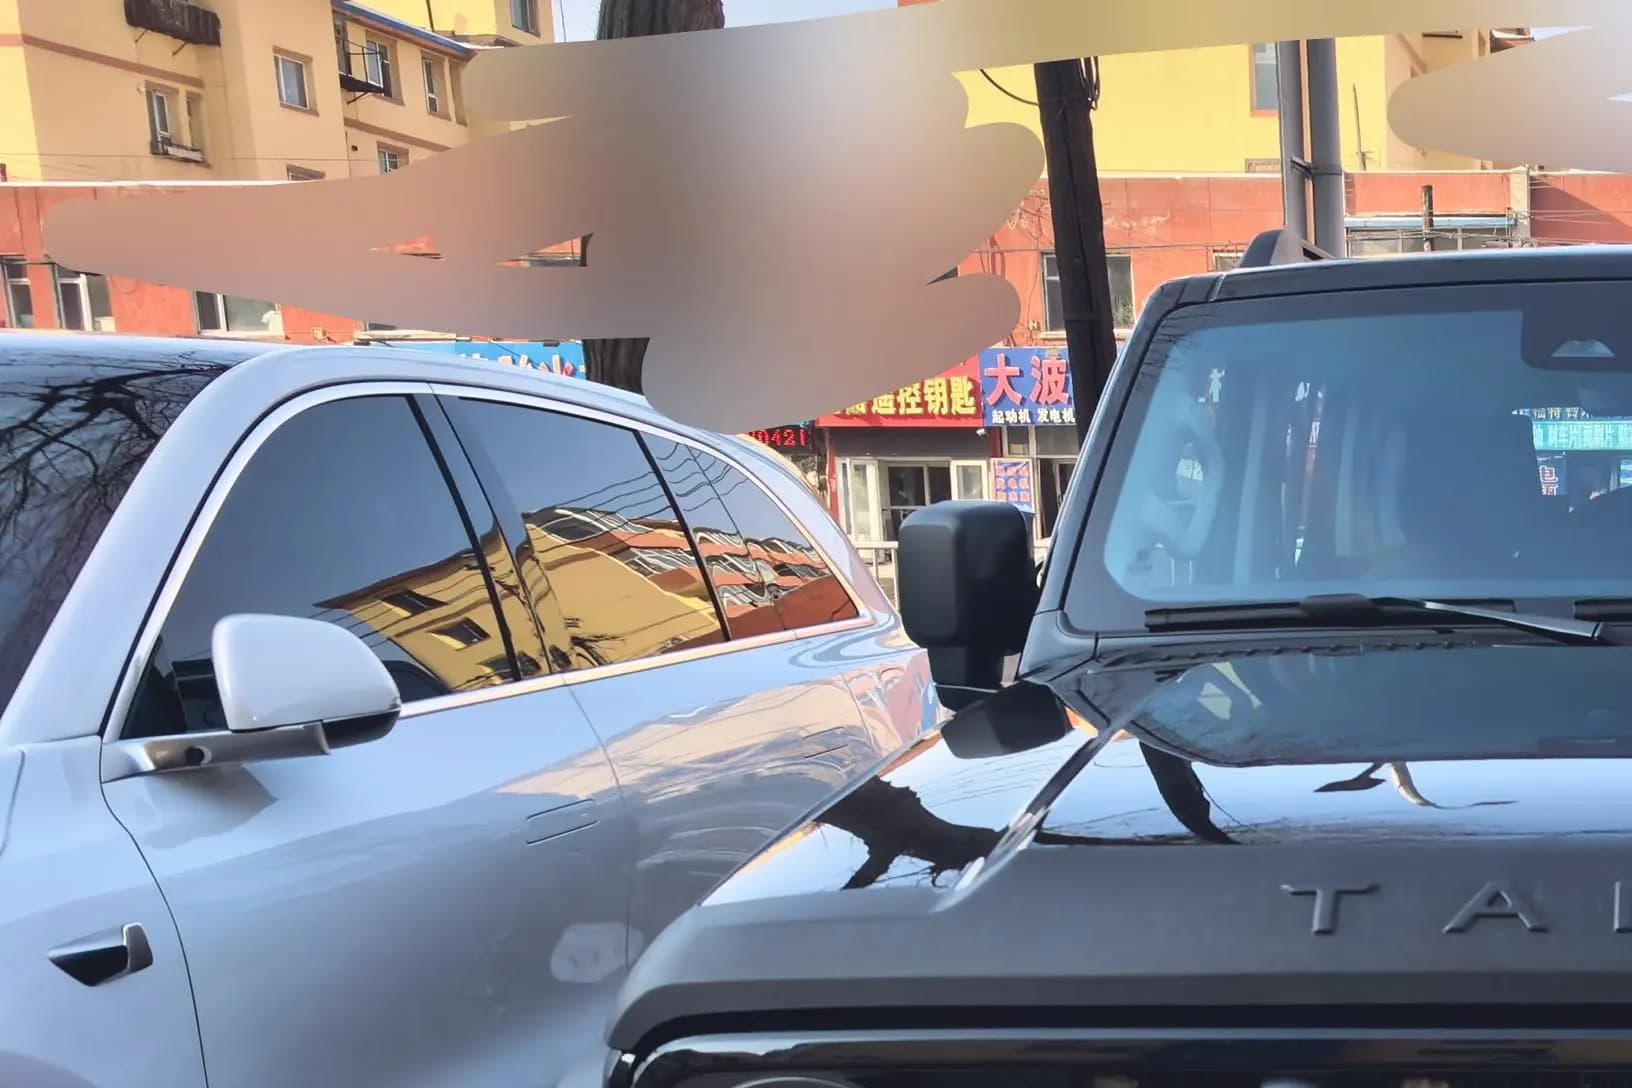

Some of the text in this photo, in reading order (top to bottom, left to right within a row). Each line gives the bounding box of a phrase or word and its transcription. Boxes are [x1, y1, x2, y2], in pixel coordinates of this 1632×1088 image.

[847, 375, 976, 415] 遥控钥匙
[984, 352, 1069, 405] 大波
[992, 407, 1076, 425] 起动机 发电机
